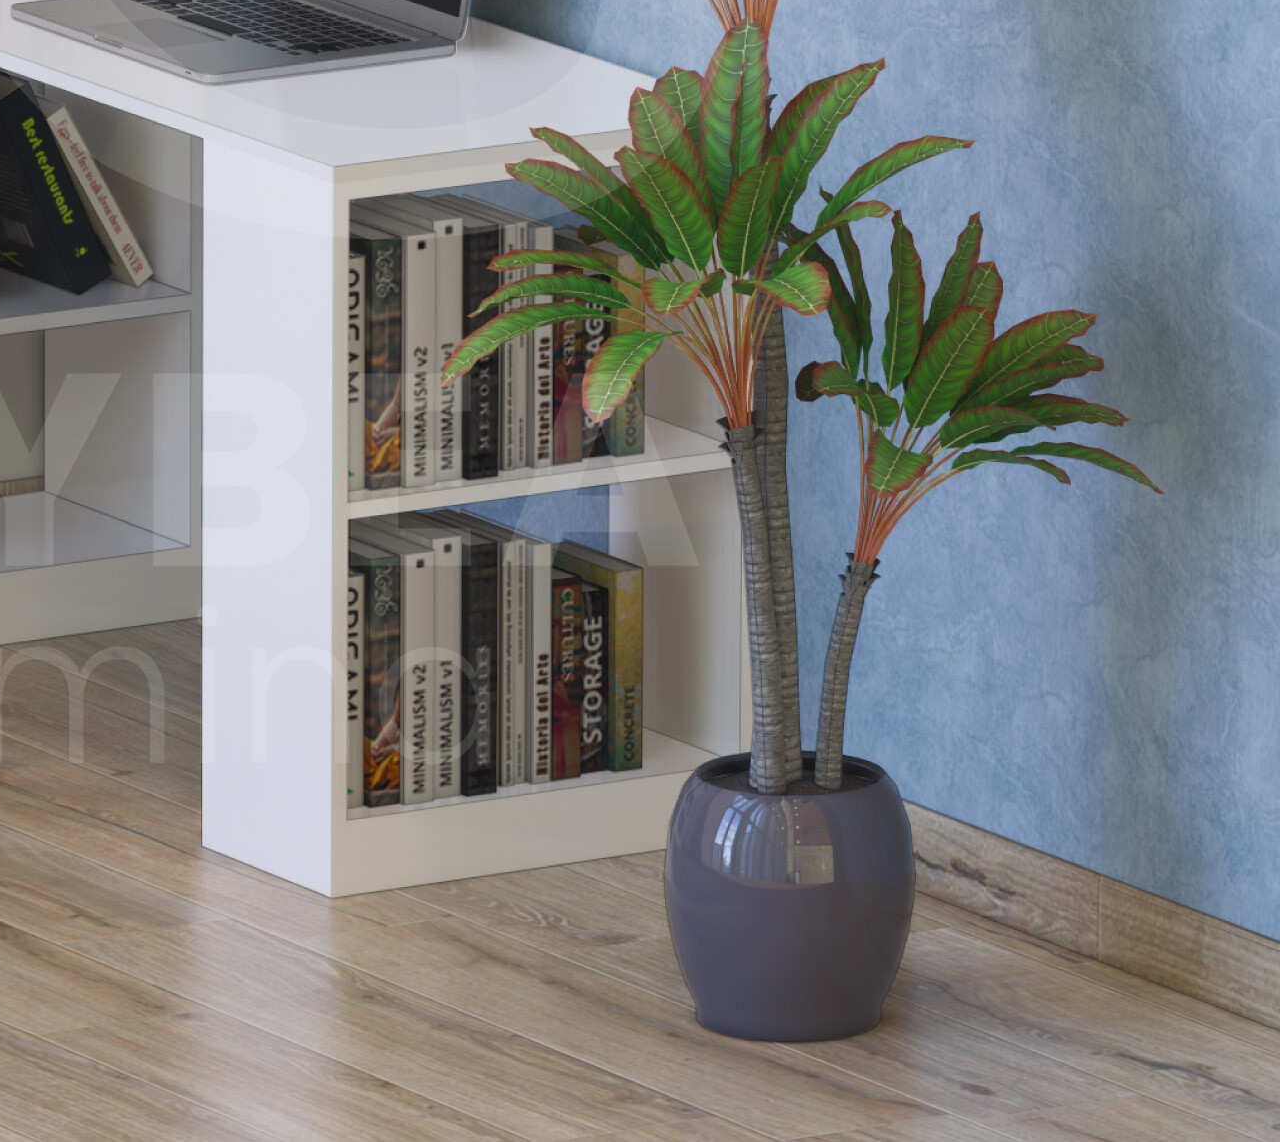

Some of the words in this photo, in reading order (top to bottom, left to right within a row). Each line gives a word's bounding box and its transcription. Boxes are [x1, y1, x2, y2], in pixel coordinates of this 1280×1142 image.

[21, 116, 41, 150] Best
[36, 149, 74, 225] restaurants
[414, 346, 428, 362] v2
[537, 336, 551, 370] Arte
[537, 374, 551, 396] del
[414, 363, 428, 478] MINIMALISM
[441, 381, 454, 470] MINIMALI
[537, 401, 551, 460] Historia
[560, 588, 574, 682] CULTURES
[413, 664, 427, 680] v2
[440, 660, 454, 678] v1
[536, 653, 550, 686] Arte
[584, 615, 602, 744] STORAGE
[536, 692, 549, 712] del
[624, 685, 635, 762] CONCRETE
[413, 681, 427, 794] MINIMALISM
[440, 680, 454, 788] MINIMALISM
[536, 716, 549, 776] Historia
